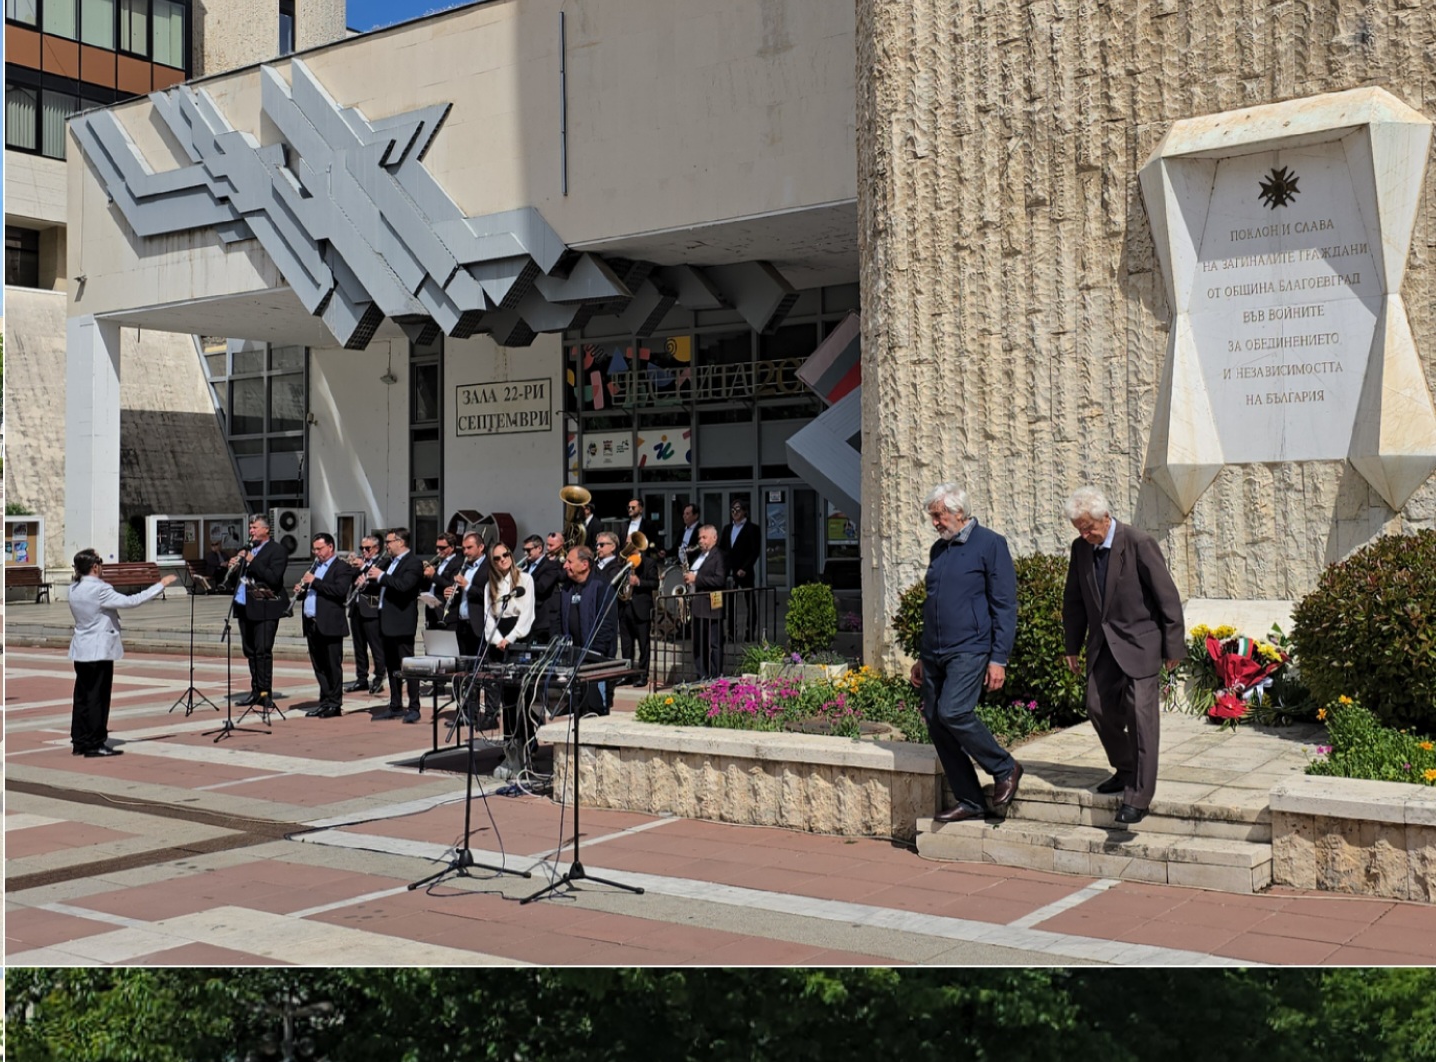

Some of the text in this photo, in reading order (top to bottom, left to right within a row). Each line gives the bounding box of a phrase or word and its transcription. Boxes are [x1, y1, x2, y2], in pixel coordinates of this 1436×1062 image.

[1230, 218, 1335, 242] ПОКЛОН И СЛАВА
[1202, 243, 1369, 273] НА ЗАГИНАЛИТЕ ГРАЖДАНИ
[1207, 273, 1361, 299] ОТ ОБЩИНА БЛАГОЕВГРАД
[1242, 305, 1325, 324] ВЪВ ВОЙНИТЕ
[1227, 332, 1340, 353] ЗА ОБЕДИНЕНИЕТО
[1222, 361, 1344, 380] И НЕЗАВИСИМОСТТА
[462, 383, 545, 405] ЗАЛА 22-РИ
[1245, 389, 1325, 406] НА БЪЛГАРИЯ
[458, 410, 550, 431] СЕПТЕМВРИ
